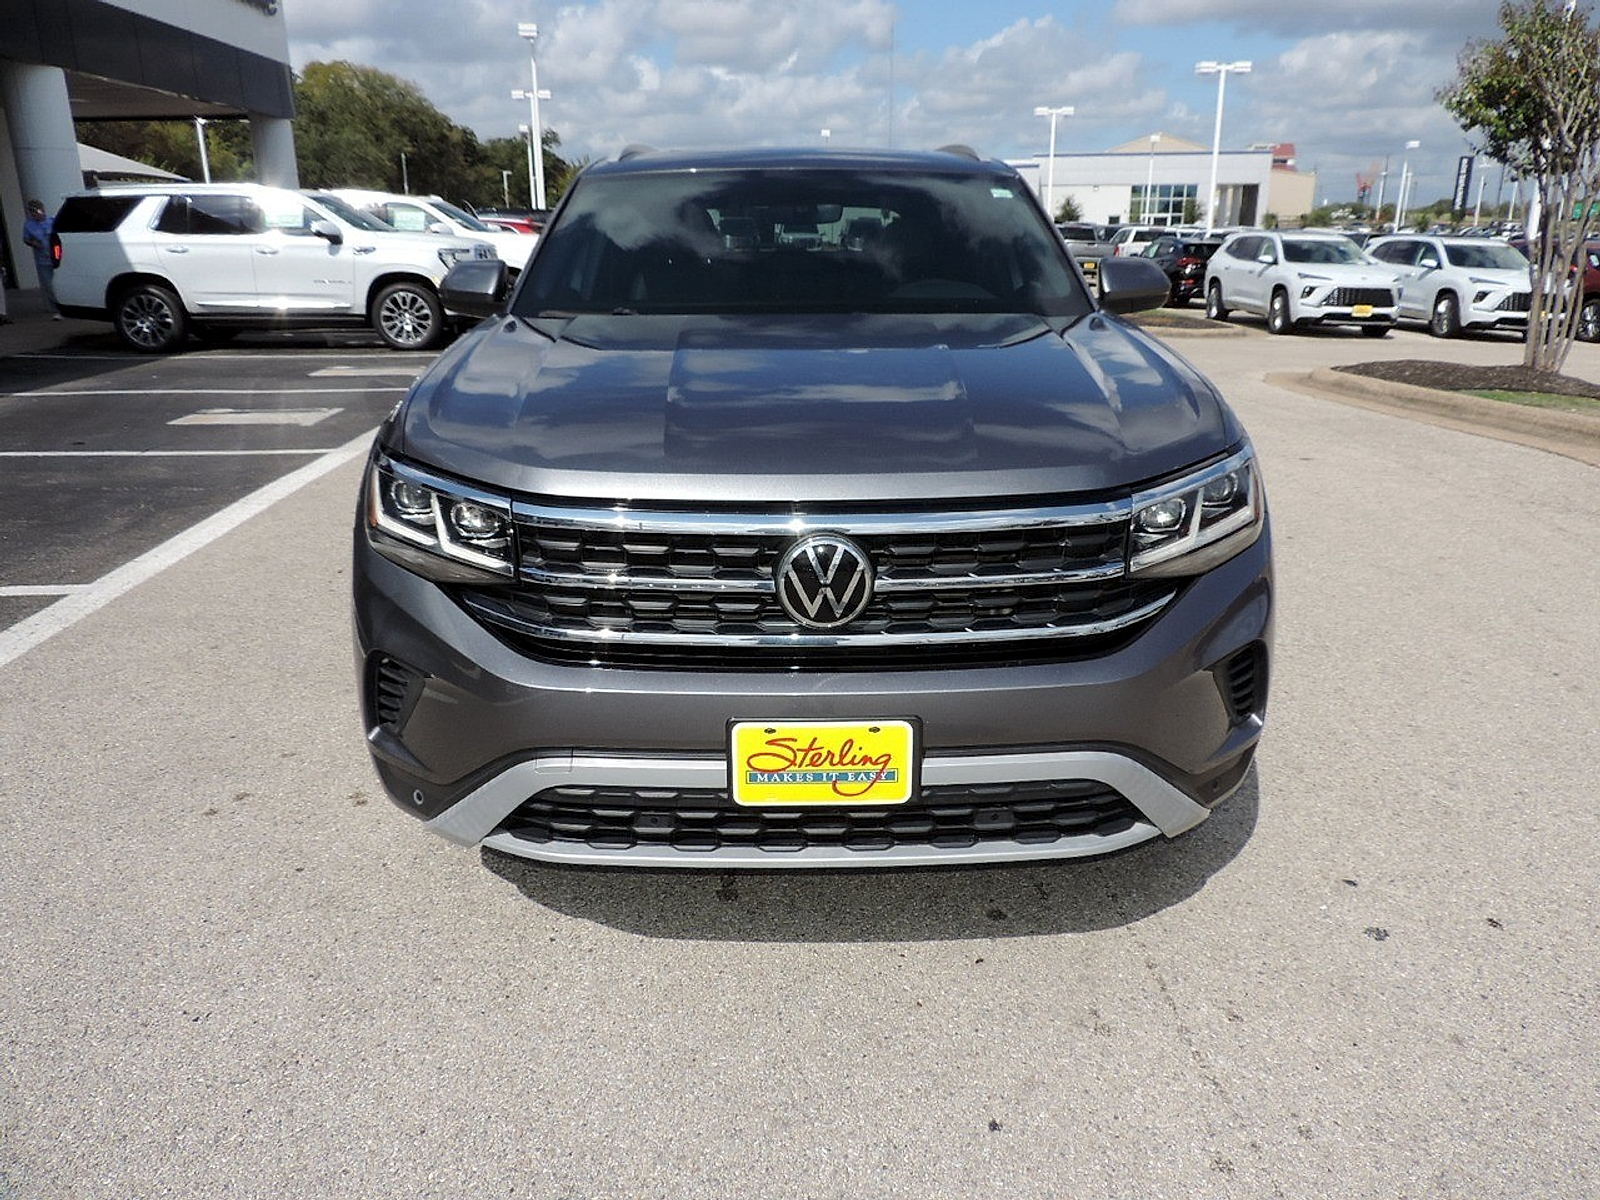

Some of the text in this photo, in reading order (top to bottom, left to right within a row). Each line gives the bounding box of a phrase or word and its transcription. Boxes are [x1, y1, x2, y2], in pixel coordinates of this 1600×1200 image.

[784, 538, 868, 621] VW
[747, 737, 892, 796] Sterling
[757, 771, 888, 782] MAKES IT EASY
